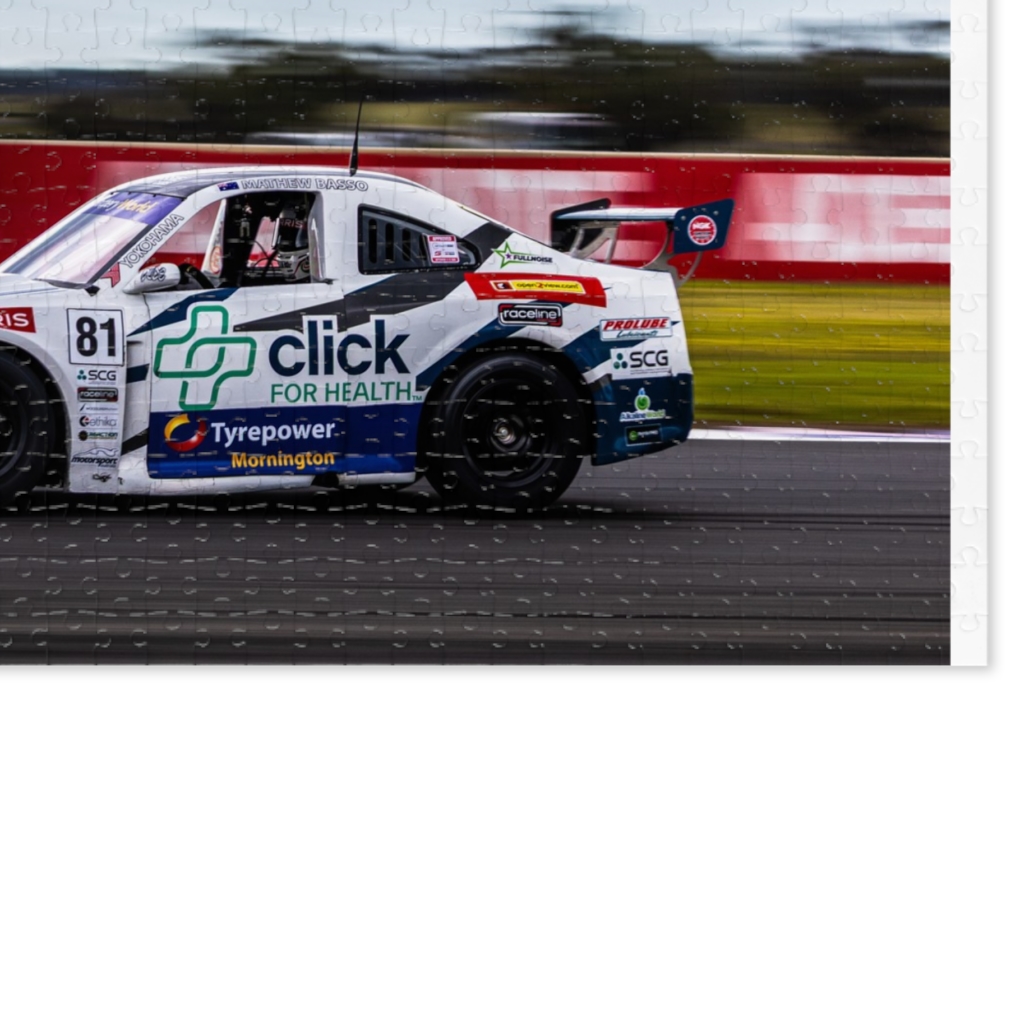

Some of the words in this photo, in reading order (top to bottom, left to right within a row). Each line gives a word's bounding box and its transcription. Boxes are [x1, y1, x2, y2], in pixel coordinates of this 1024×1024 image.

[241, 178, 312, 189] MATHEW
[315, 178, 369, 191] BASSO
[119, 213, 185, 269] YOKOHAMA
[513, 254, 553, 263] FULLNOISE
[503, 308, 557, 319] raceline
[603, 318, 669, 332] PROLUBE
[76, 316, 118, 357] 81
[268, 319, 411, 377] click
[629, 350, 669, 369] SCG
[88, 370, 117, 381] SCG
[270, 383, 317, 403] FOR
[325, 381, 412, 402] HEALTH
[210, 422, 336, 447] Tyrepower
[70, 457, 119, 467] motorsport
[231, 450, 335, 470] Mornington
